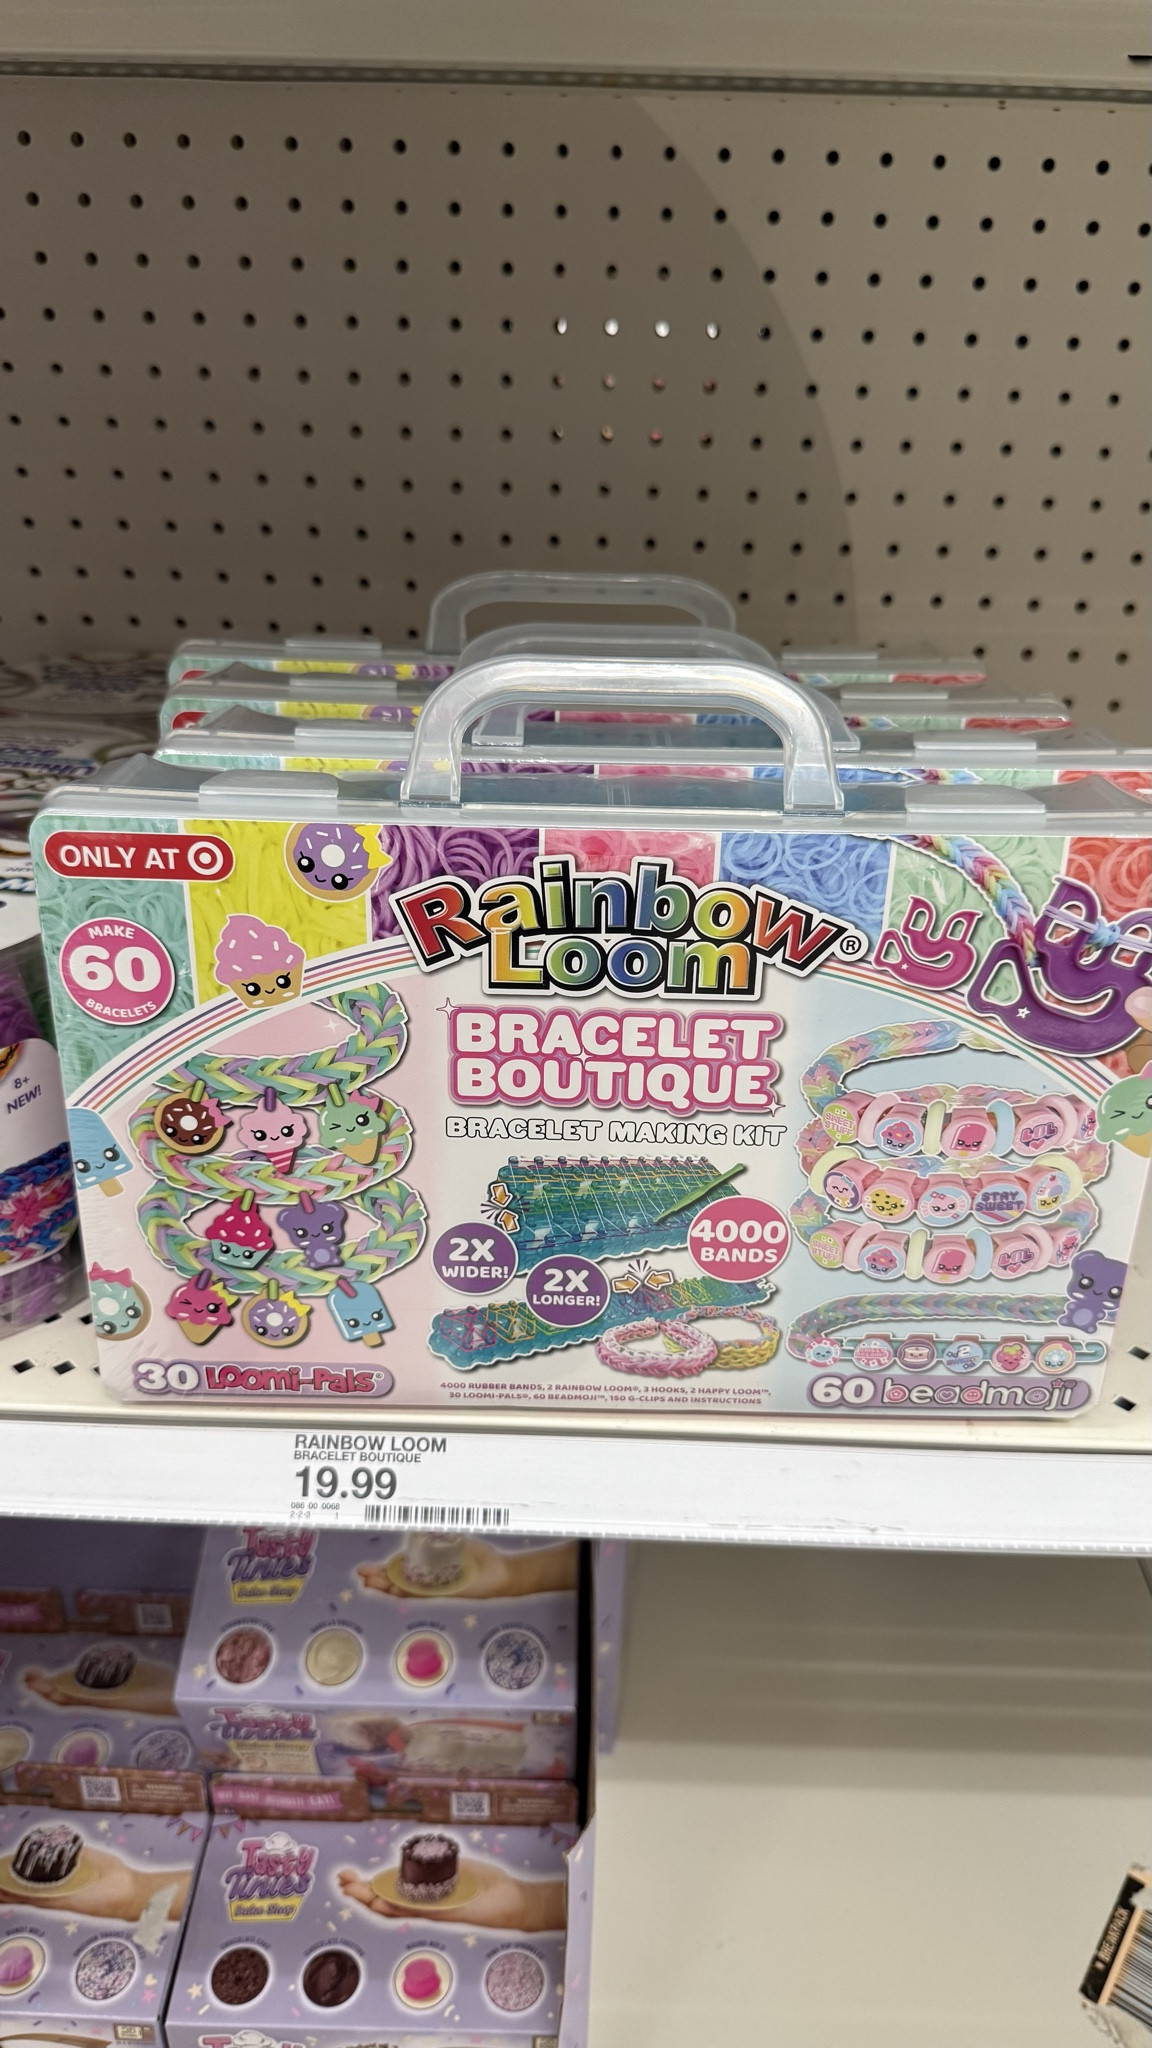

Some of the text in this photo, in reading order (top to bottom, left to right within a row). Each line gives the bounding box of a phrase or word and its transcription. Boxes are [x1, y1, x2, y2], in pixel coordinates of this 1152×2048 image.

[59, 845, 136, 868] ONLY
[145, 847, 180, 870] AT
[396, 861, 843, 970] Rainbow
[87, 924, 136, 940] MAKE
[68, 944, 162, 992] 60
[486, 927, 757, 994] Loom
[84, 997, 158, 1019] BRACELETS
[456, 1012, 774, 1060] BRACELET
[14, 1077, 30, 1089] 8+
[456, 1057, 771, 1109] BOUTIQUE
[6, 1084, 42, 1114] NEW!
[446, 1116, 788, 1147] BRACELET MAKING KIT
[825, 1111, 854, 1128] SWEET
[1020, 1122, 1058, 1143] LOL
[974, 1200, 1025, 1212] SWEET
[981, 1191, 1019, 1201] STAY
[691, 1219, 786, 1244] 4000
[449, 1237, 495, 1262] 2X
[700, 1247, 778, 1263] BANDS
[997, 1247, 1035, 1267] LOL
[441, 1265, 509, 1279] WIDER!
[543, 1268, 589, 1292] 2X
[532, 1294, 601, 1307] LONGER!
[137, 1362, 200, 1391] 30
[440, 1382, 466, 1390] 4000
[468, 1383, 508, 1391] RUBBER
[510, 1383, 545, 1392] BANDS,
[555, 1384, 602, 1392] RAINBOW
[651, 1386, 688, 1394] HOOKS,
[698, 1387, 730, 1395] HAPPY
[690, 1396, 762, 1404] INSTRUCTIONS
[812, 1375, 1078, 1411] 60 beadmoji
[295, 1434, 447, 1452] RAINBOW LOOM
[294, 1450, 421, 1463] BRACELET BOUTIQUE
[295, 1465, 397, 1500] 19.99
[242, 1839, 316, 1877] Tasty
[225, 1867, 312, 1899] Tinies
